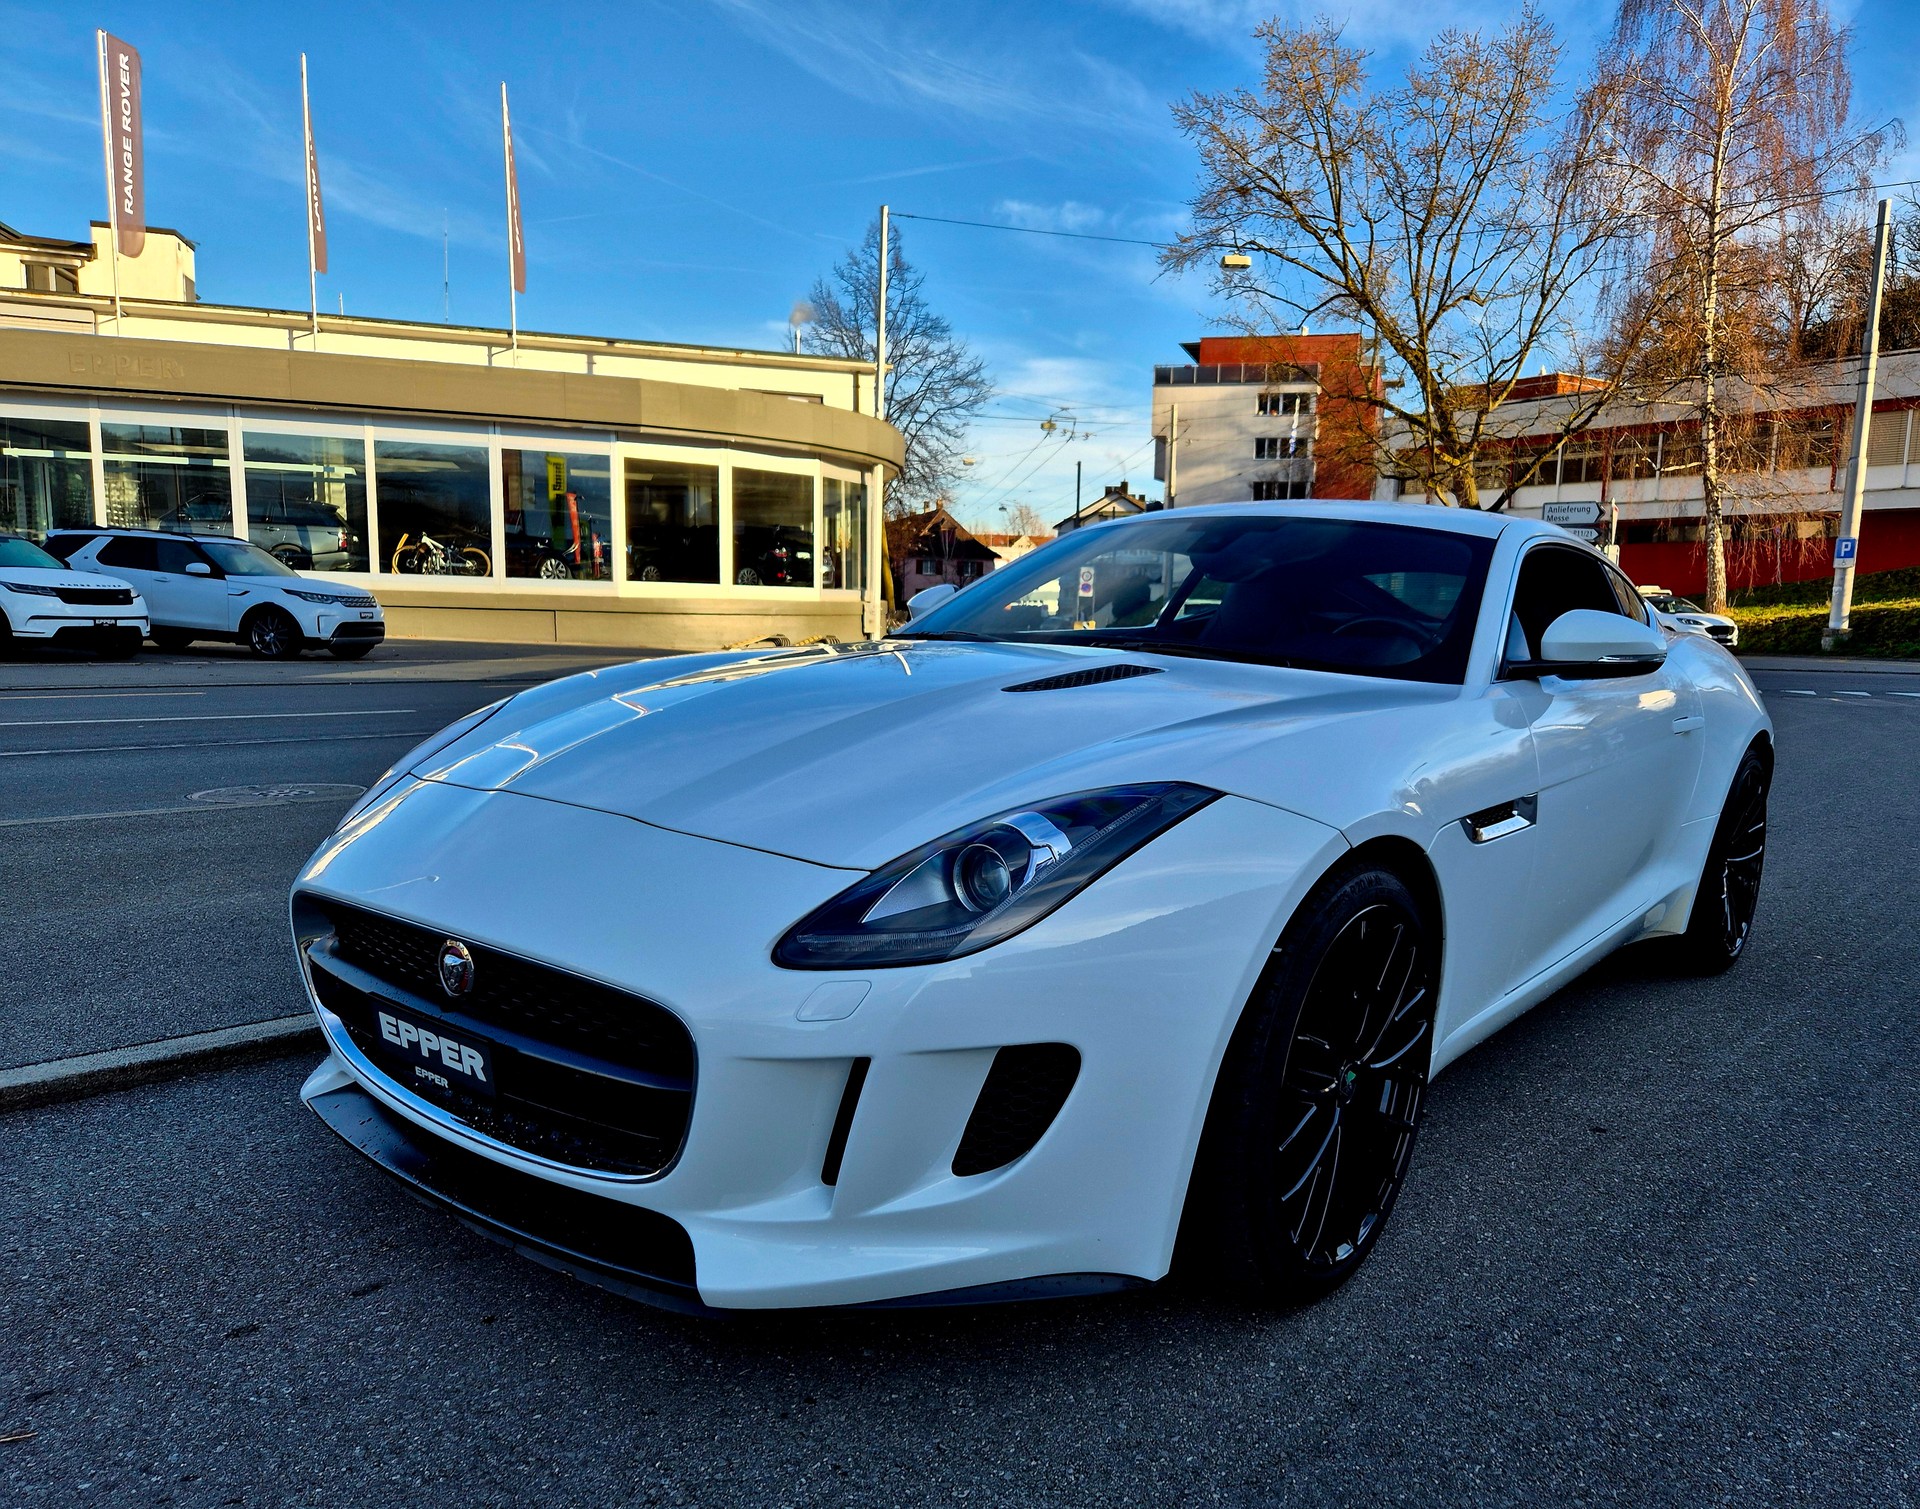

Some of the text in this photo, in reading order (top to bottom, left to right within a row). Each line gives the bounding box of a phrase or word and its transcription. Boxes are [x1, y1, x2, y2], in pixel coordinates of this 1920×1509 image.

[119, 53, 134, 215] RANGE ROVER
[67, 351, 185, 379] EPPER
[1547, 506, 1591, 514] Anlieferung
[1840, 541, 1852, 557] P
[379, 1011, 487, 1082] EPPER
[415, 1066, 449, 1088] EPPER
